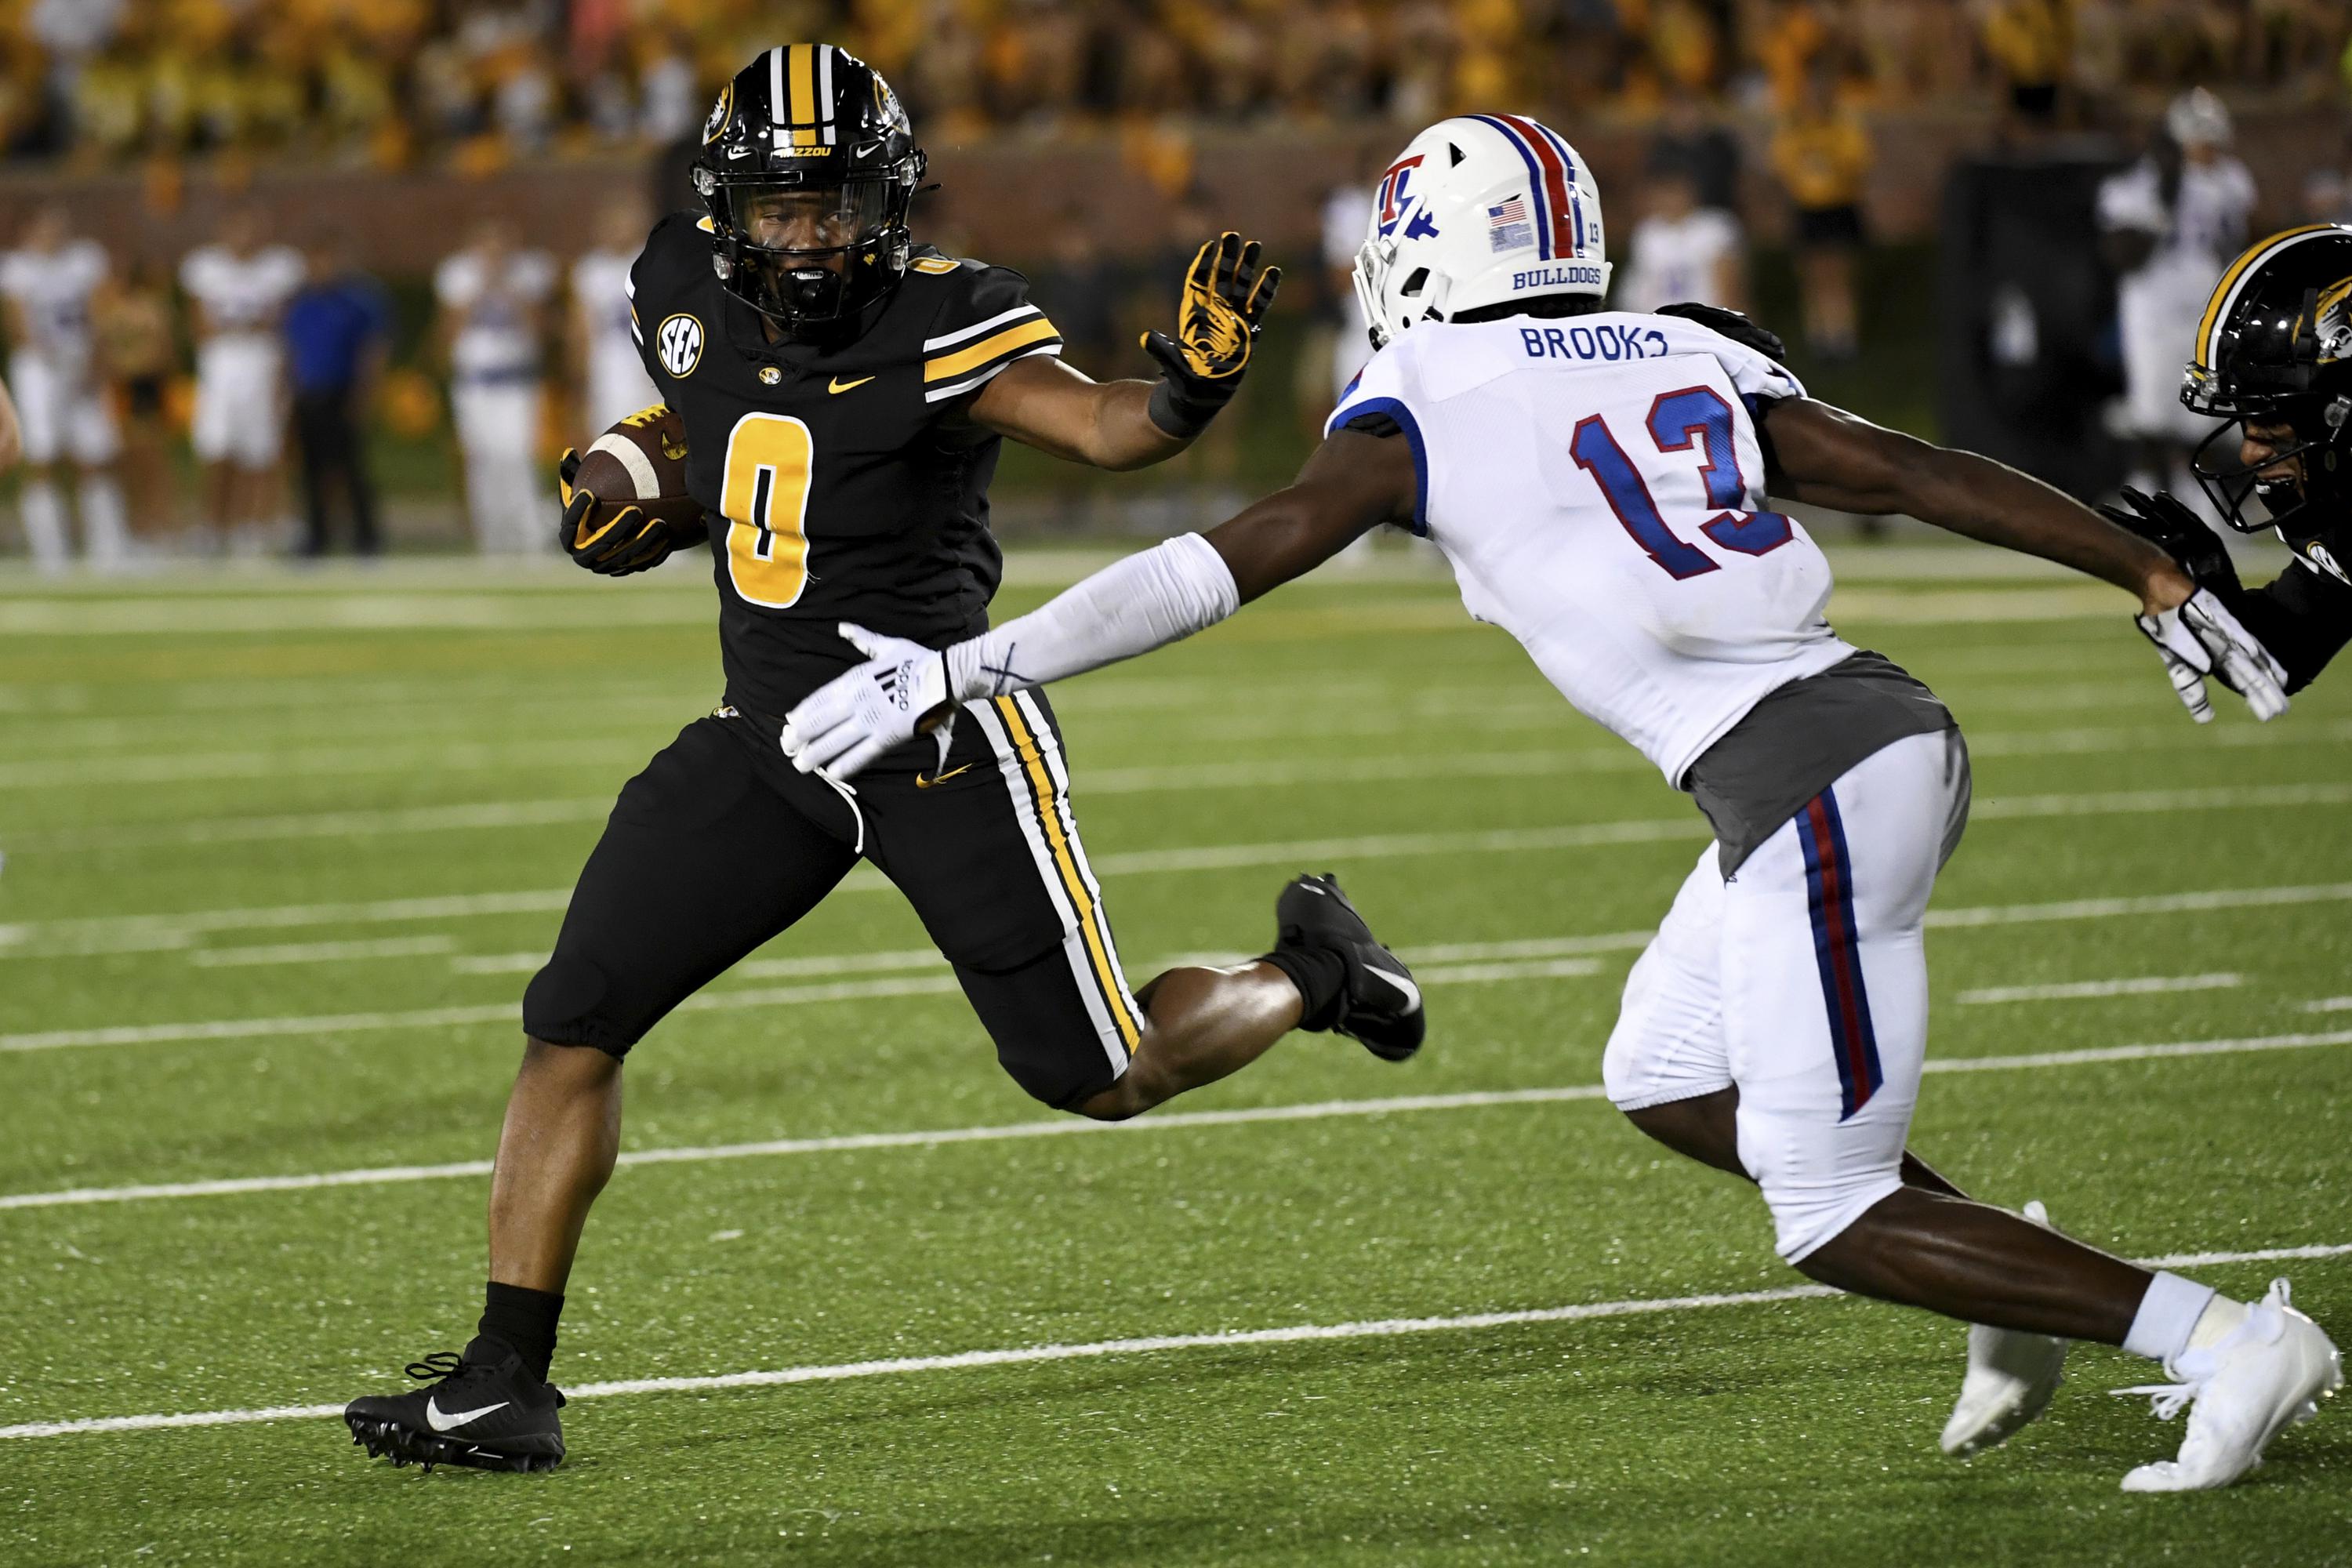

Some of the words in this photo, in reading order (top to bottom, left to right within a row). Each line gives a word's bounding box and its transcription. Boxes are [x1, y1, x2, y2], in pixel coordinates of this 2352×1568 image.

[1589, 223, 1599, 243] 13
[1512, 267, 1601, 290] BULLDOGS
[661, 318, 700, 374] SEC
[720, 412, 814, 608] 0
[1569, 385, 1794, 581] 13
